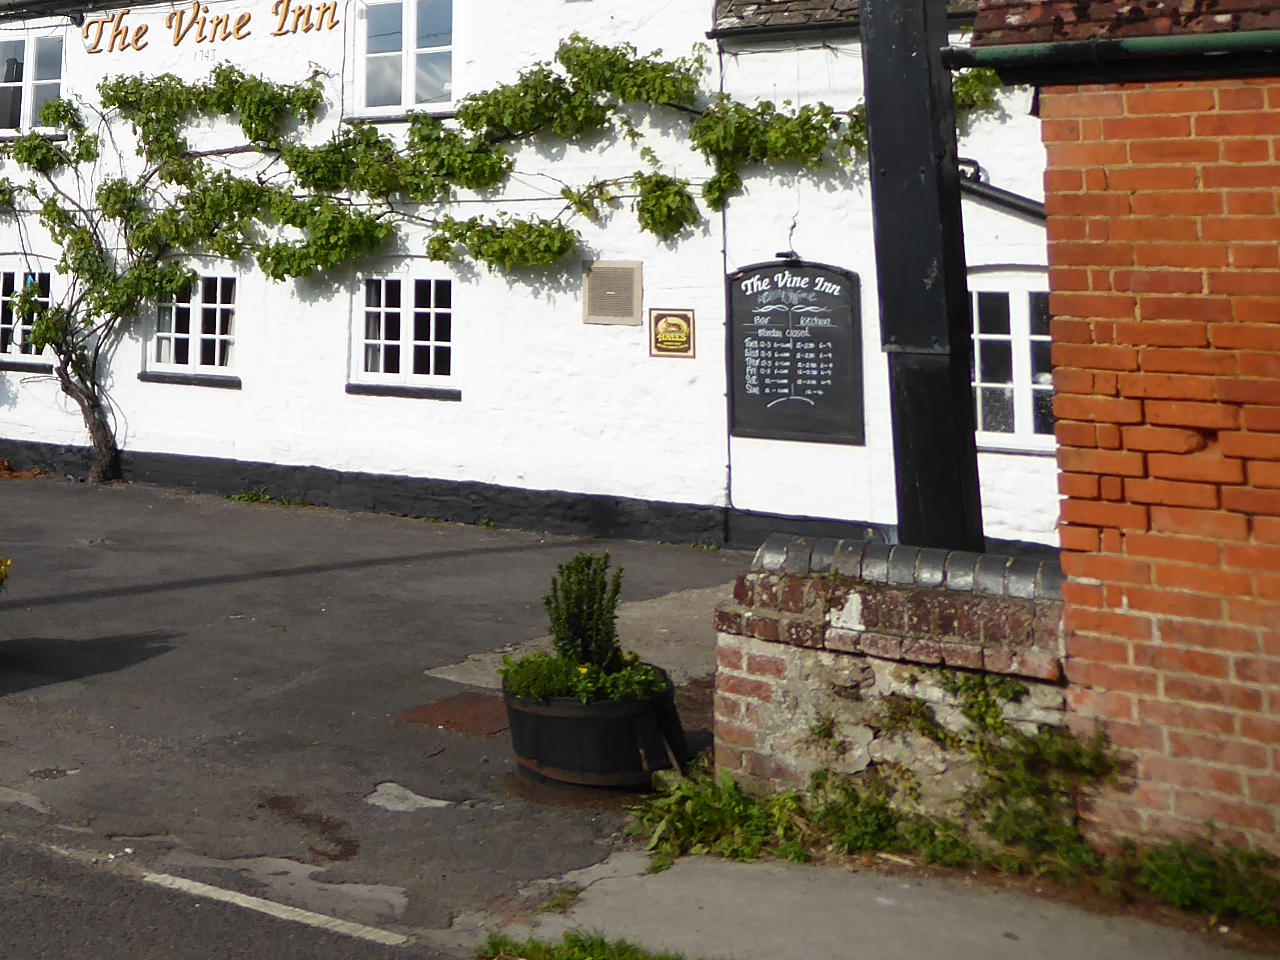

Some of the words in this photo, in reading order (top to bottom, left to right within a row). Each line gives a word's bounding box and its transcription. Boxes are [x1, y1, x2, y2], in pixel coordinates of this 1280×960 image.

[82, 9, 149, 54] The
[165, 0, 252, 47] Vine
[193, 48, 217, 62] 1743
[741, 275, 771, 295] The
[773, 270, 809, 288] Vine
[813, 277, 841, 296] Inn
[753, 316, 771, 324] Bar
